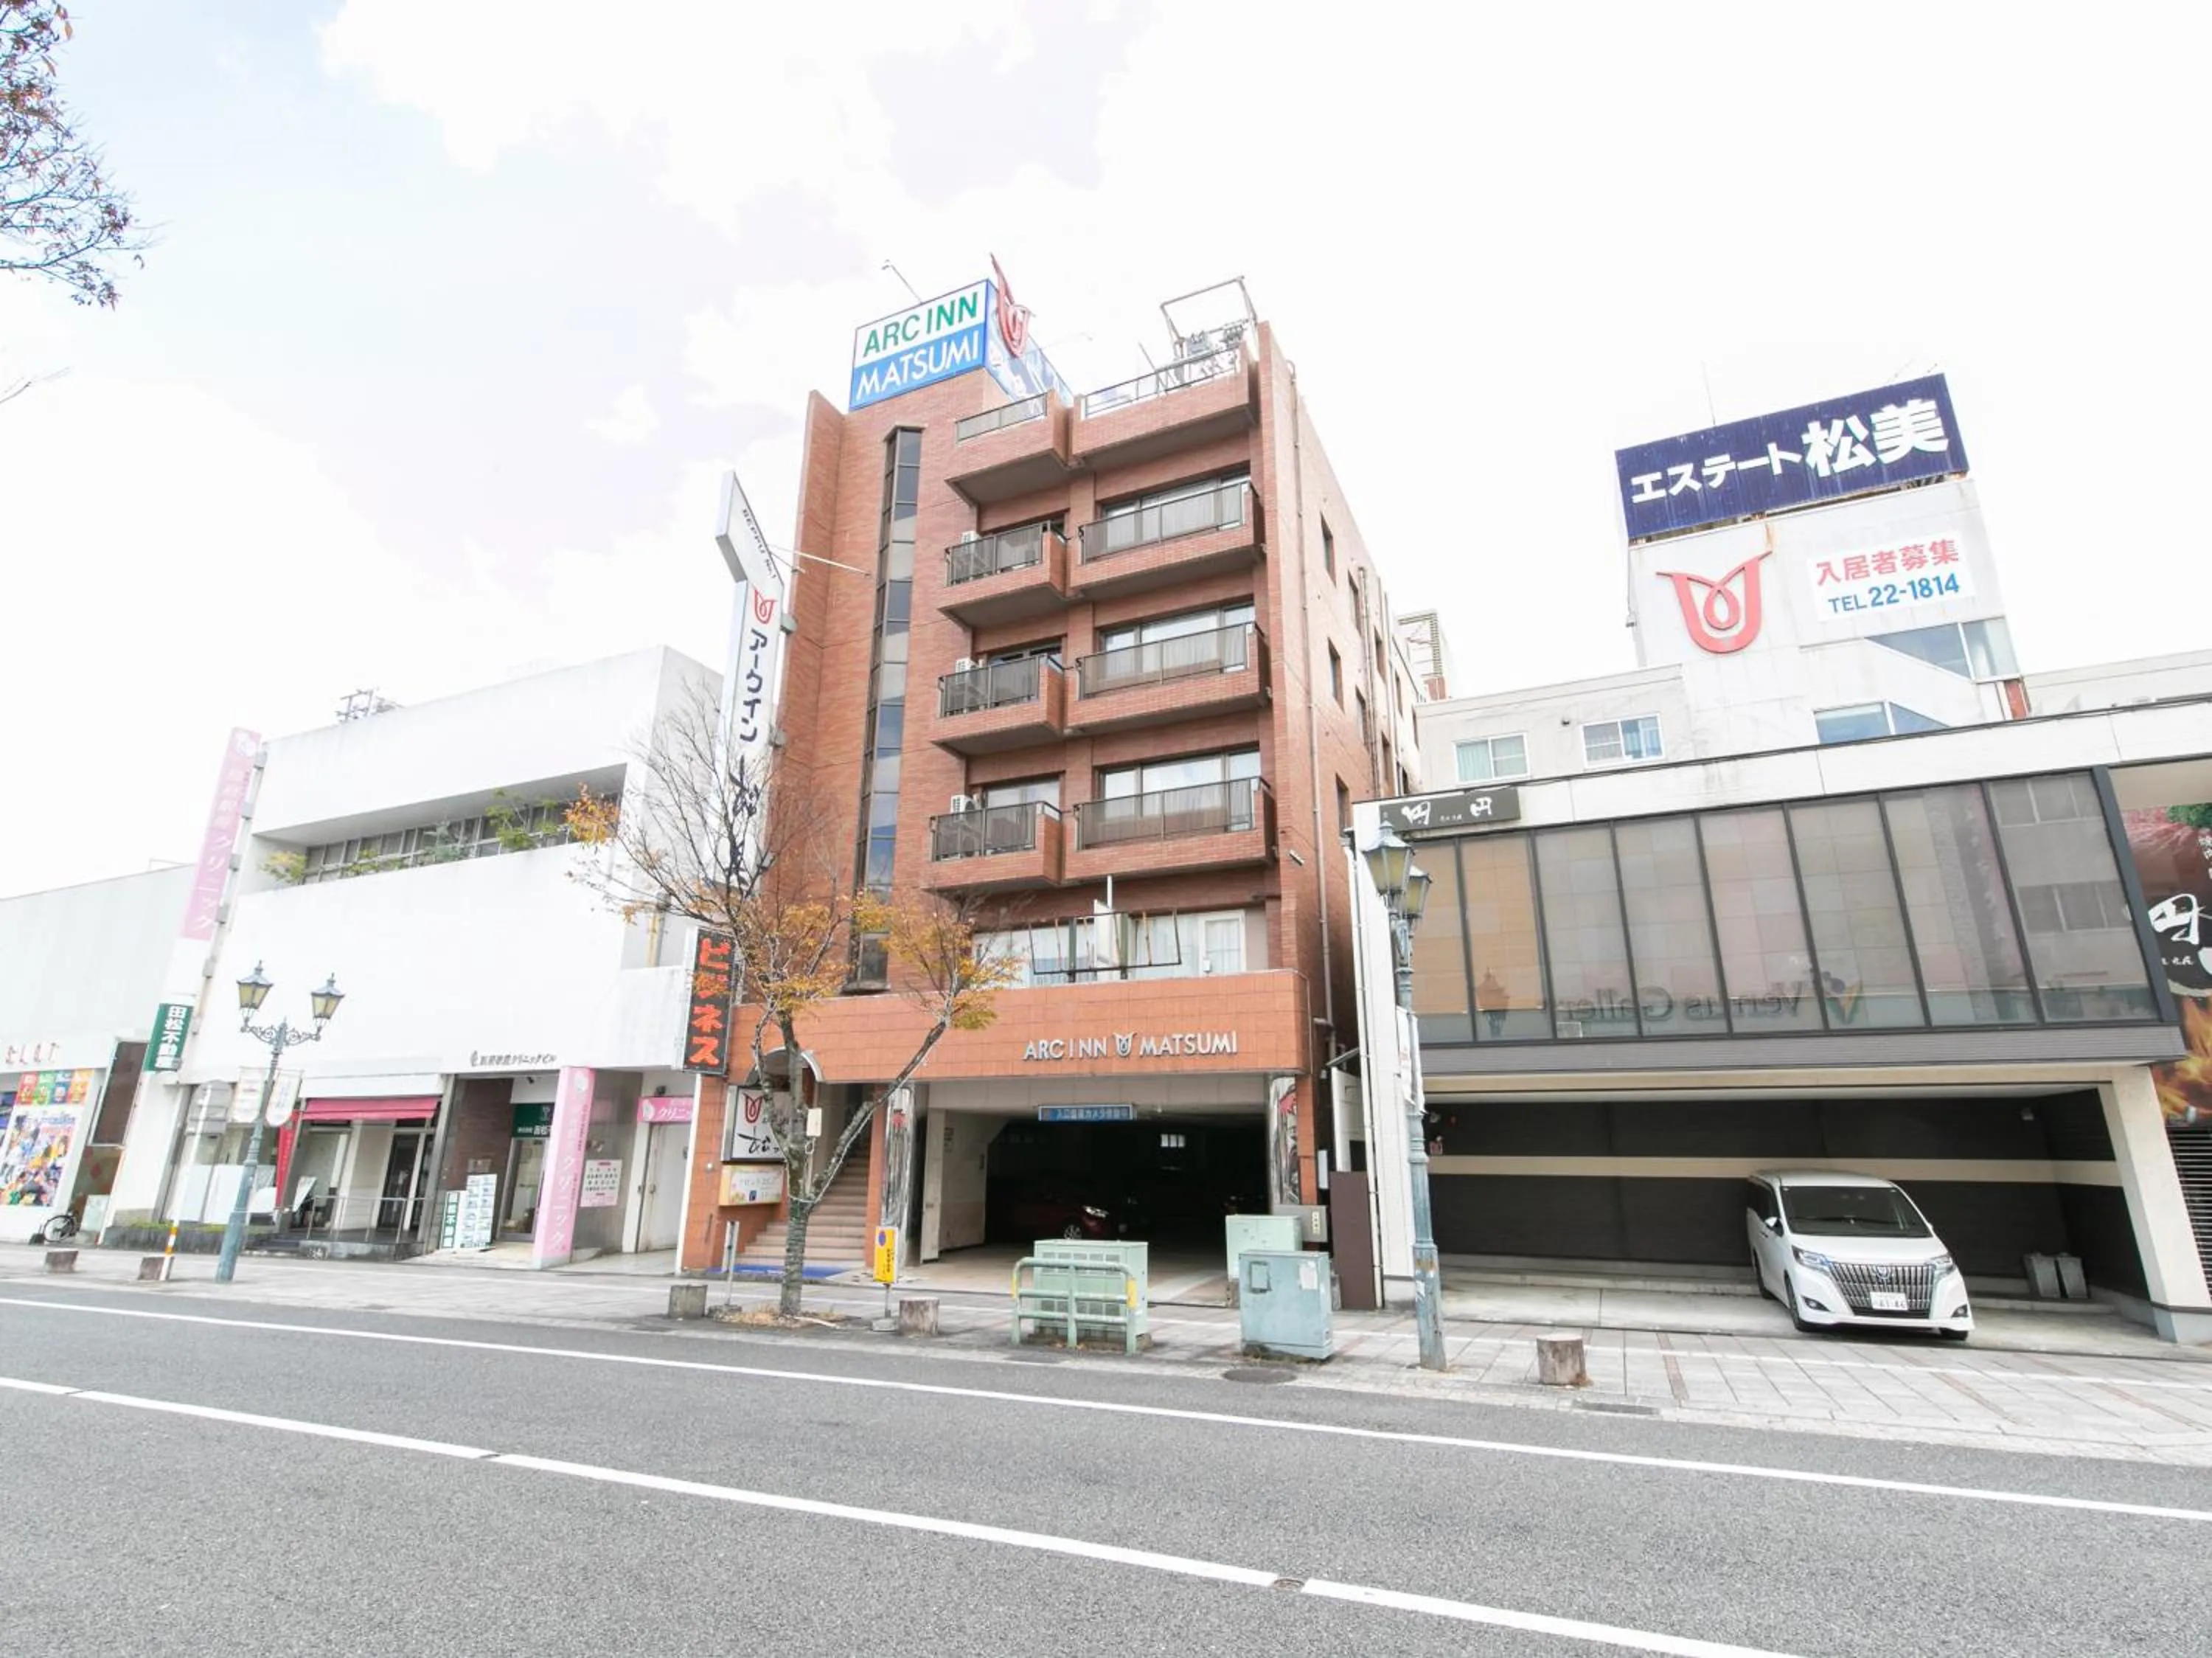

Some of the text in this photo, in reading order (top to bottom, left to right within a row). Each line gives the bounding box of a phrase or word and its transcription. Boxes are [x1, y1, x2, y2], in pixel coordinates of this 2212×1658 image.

[862, 291, 978, 358] ARC INN
[855, 330, 980, 400] MATSUMI
[1631, 398, 1950, 504] エステート松美
[1815, 539, 1959, 586] 入居者募集
[1828, 572, 1960, 614] TEL 22-1814
[1023, 1030, 1238, 1061] ARC INN MATSUMI
